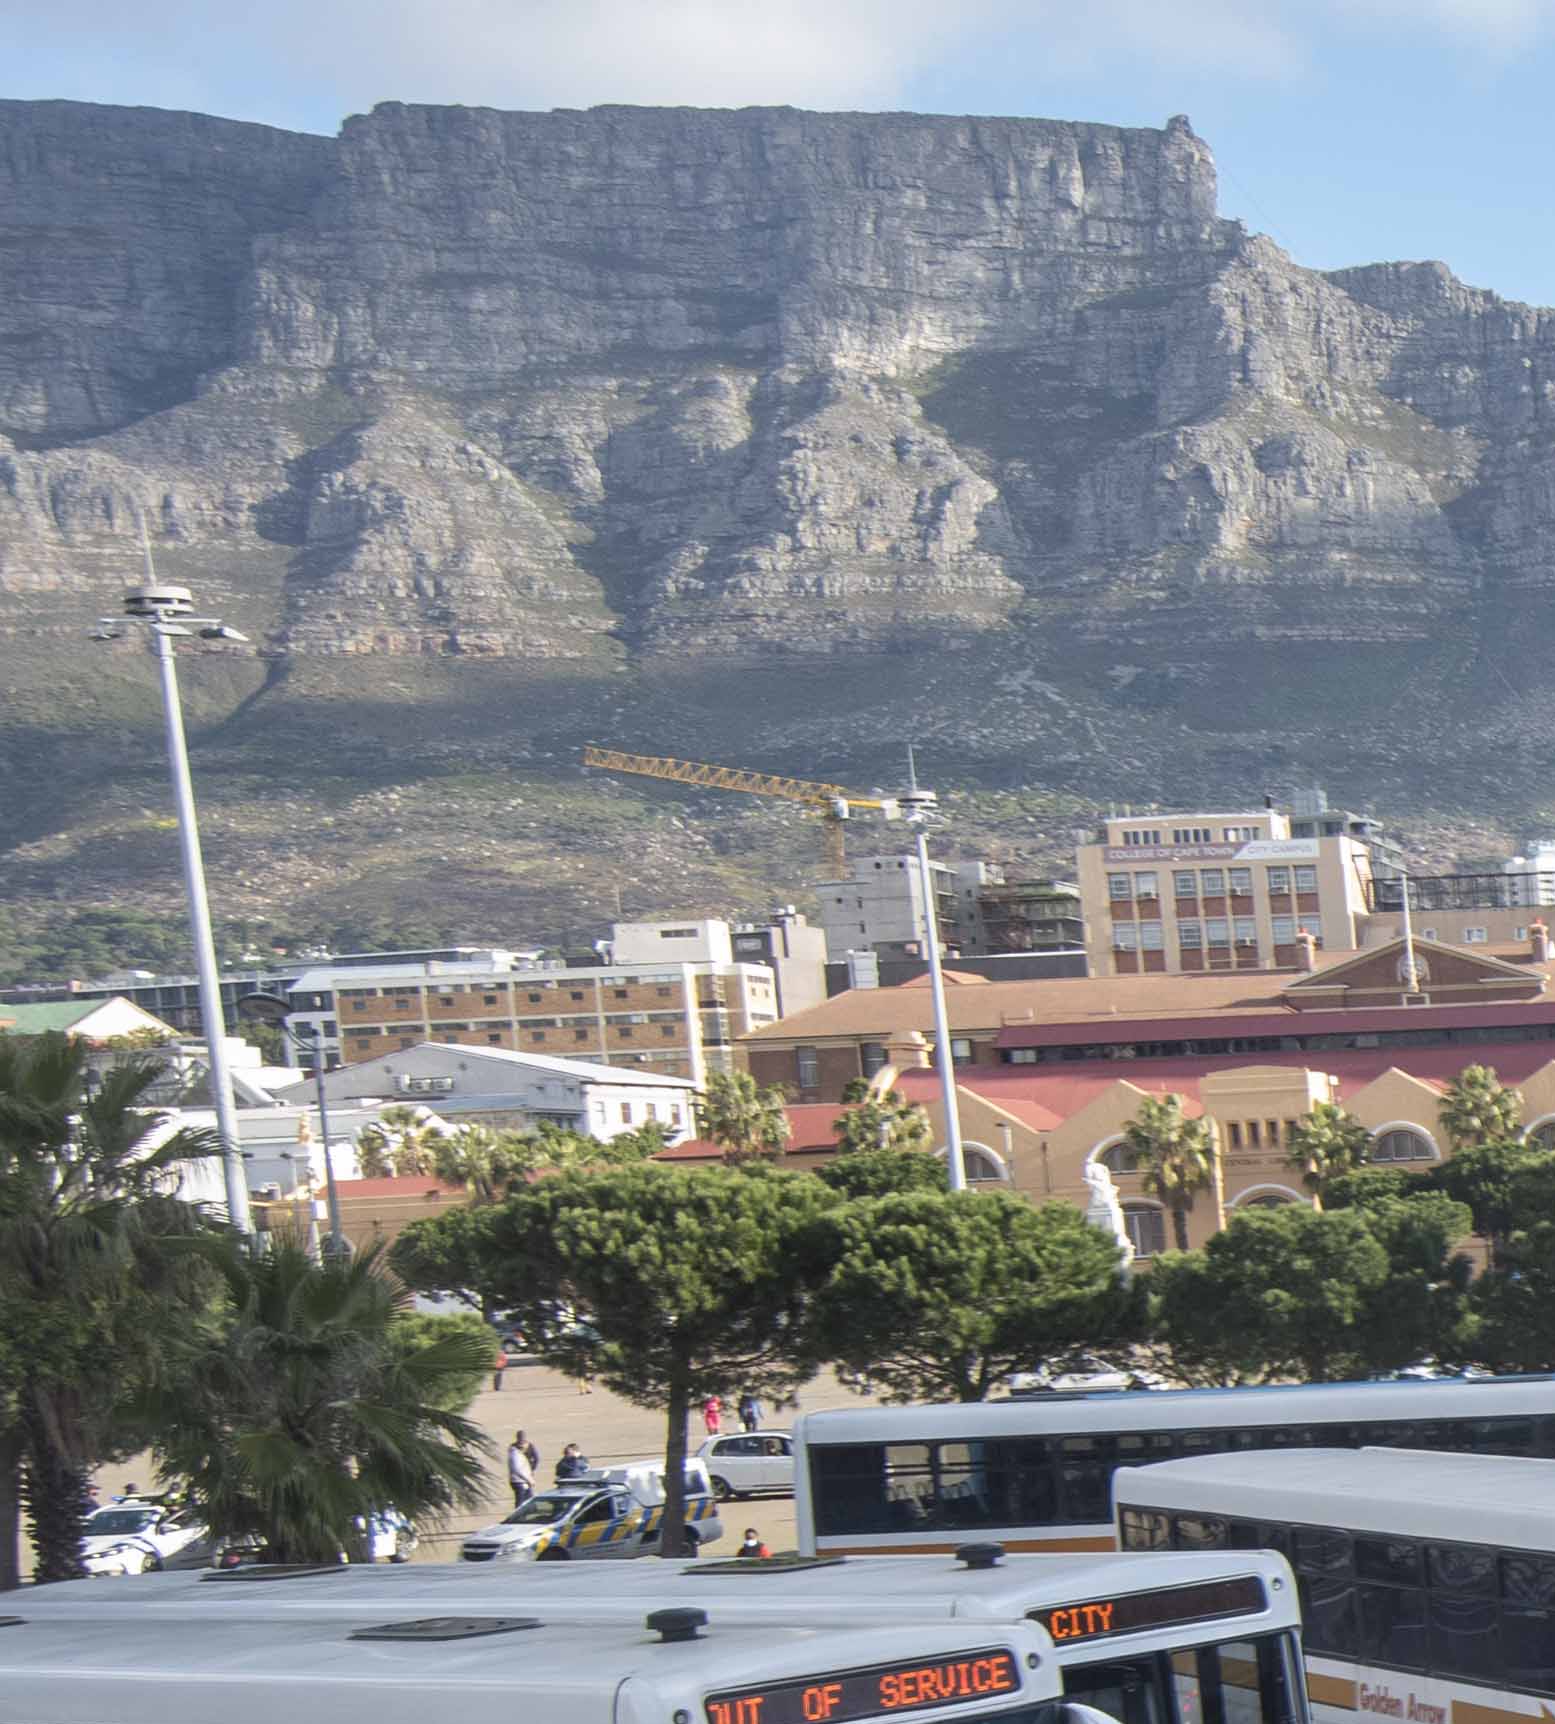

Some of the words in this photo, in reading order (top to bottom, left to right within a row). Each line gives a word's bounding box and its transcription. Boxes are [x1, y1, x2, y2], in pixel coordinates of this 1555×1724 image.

[1108, 848, 1156, 860] COLLEGE
[1158, 847, 1171, 858] OF
[1173, 846, 1201, 858] CAPE
[1203, 844, 1235, 857] TOWN
[1049, 1602, 1113, 1639] CITY
[802, 1682, 844, 1722] OF
[879, 1655, 1011, 1709] SERVICE
[1359, 1683, 1404, 1719] Golden
